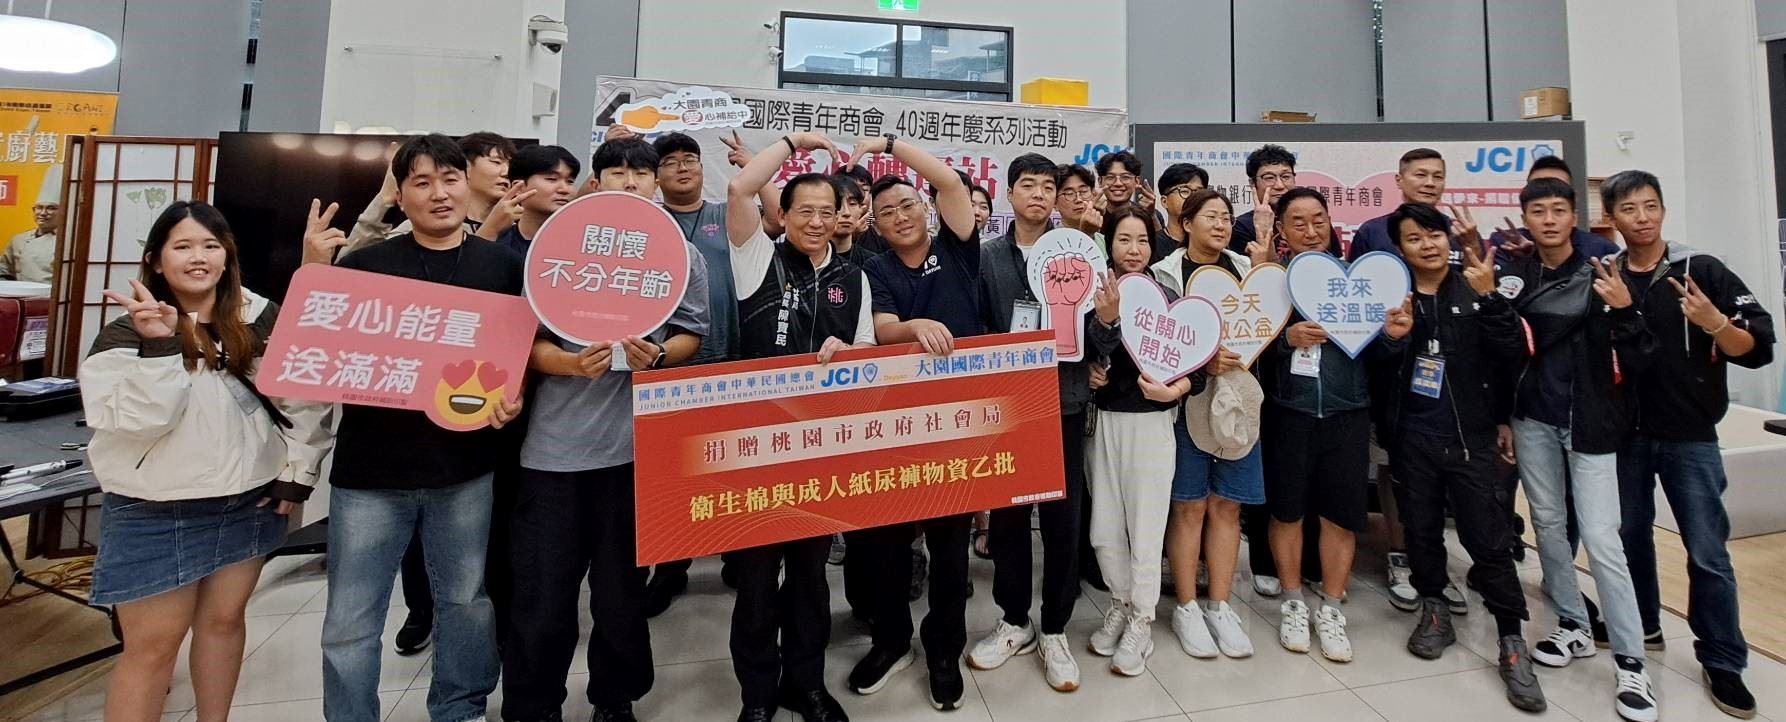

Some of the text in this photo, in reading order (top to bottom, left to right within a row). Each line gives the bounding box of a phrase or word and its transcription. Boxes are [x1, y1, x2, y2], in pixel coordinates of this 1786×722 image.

[732, 97, 1068, 149] 國際青年商會 40週年慶系列活動
[0, 129, 58, 163] 廚藝
[1465, 147, 1526, 173] JCI
[581, 223, 649, 261] 關懷
[539, 258, 674, 299] 不分年齡
[1327, 277, 1373, 298] 我來
[297, 290, 482, 348] 愛心能量
[1221, 294, 1261, 315] 今天
[1317, 302, 1387, 324] 送溫暖
[1134, 306, 1196, 346] 從關心
[276, 344, 423, 394] 送滿滿
[914, 346, 1054, 378] 大園國際青年商會
[1138, 335, 1182, 369] 開始
[638, 370, 815, 402] 國際青年商會中華民國總會
[821, 366, 859, 388] JCI
[640, 384, 815, 411] JUNIOR CHAMBER INTERNATIONAL TAIWAN
[703, 404, 1001, 463] 捐贈桃園市政府社會局
[689, 451, 1017, 522] 衛生棉與成人紙尿褲物資乙批
